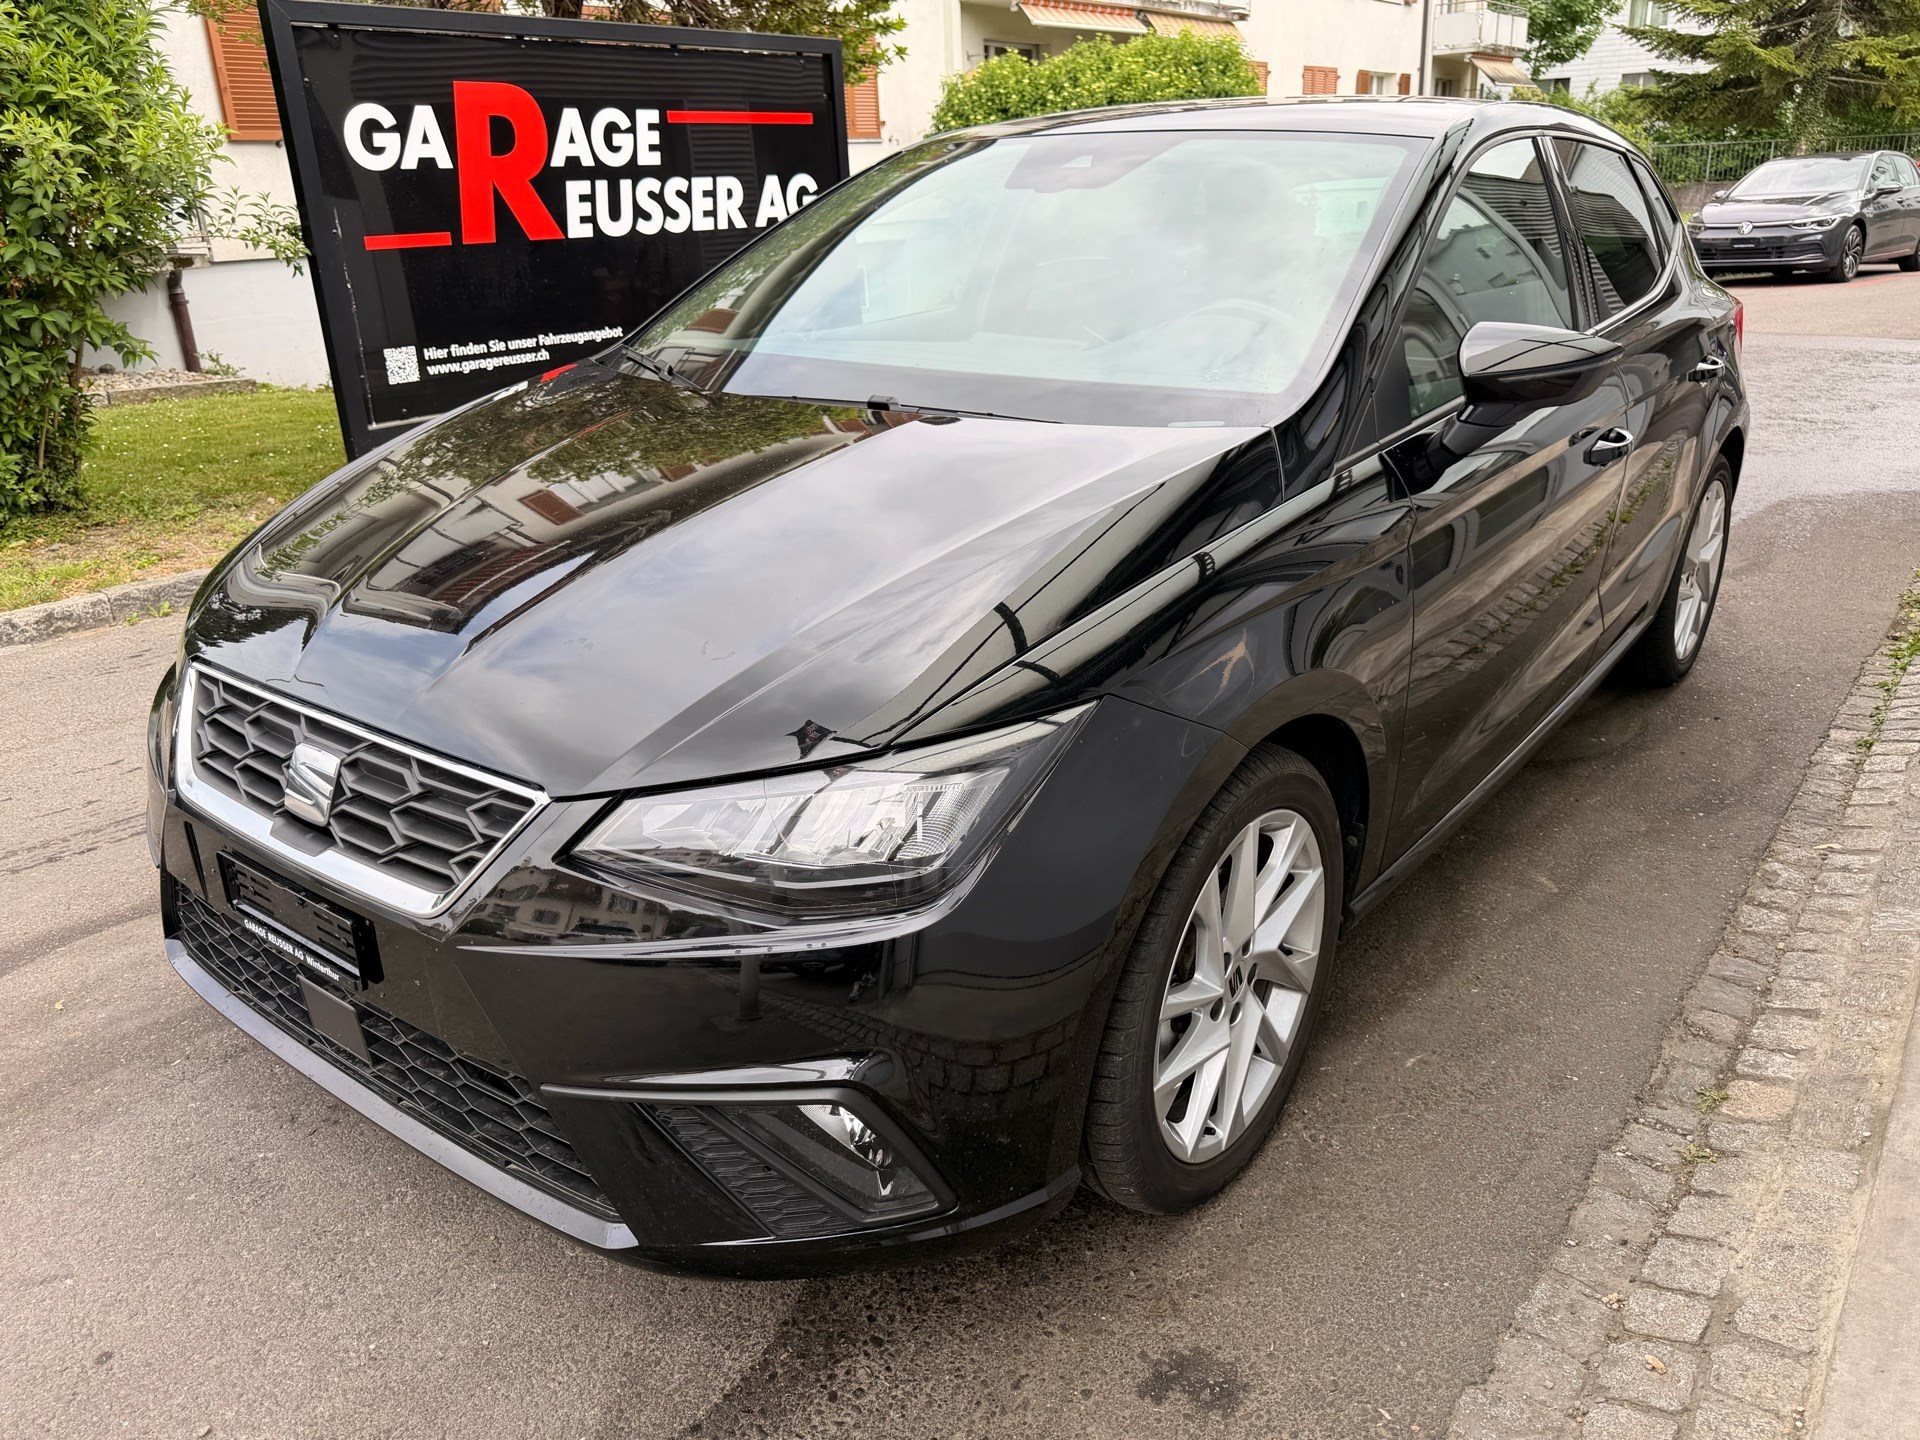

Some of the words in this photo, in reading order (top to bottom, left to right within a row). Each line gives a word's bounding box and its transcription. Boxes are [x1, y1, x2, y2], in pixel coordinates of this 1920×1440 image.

[343, 81, 661, 244] GARAGE
[754, 172, 819, 228] AG
[423, 346, 449, 361] Hier
[450, 341, 488, 357] finden
[489, 338, 507, 352] Sie
[507, 337, 538, 350] unser
[538, 326, 624, 347] Fahrzeugangebot
[426, 349, 550, 375] www.garagereusser.ch
[244, 919, 267, 939] GARAGE
[267, 932, 294, 955] REUSSER
[294, 948, 305, 961] AG
[305, 954, 340, 982] Winterthur
